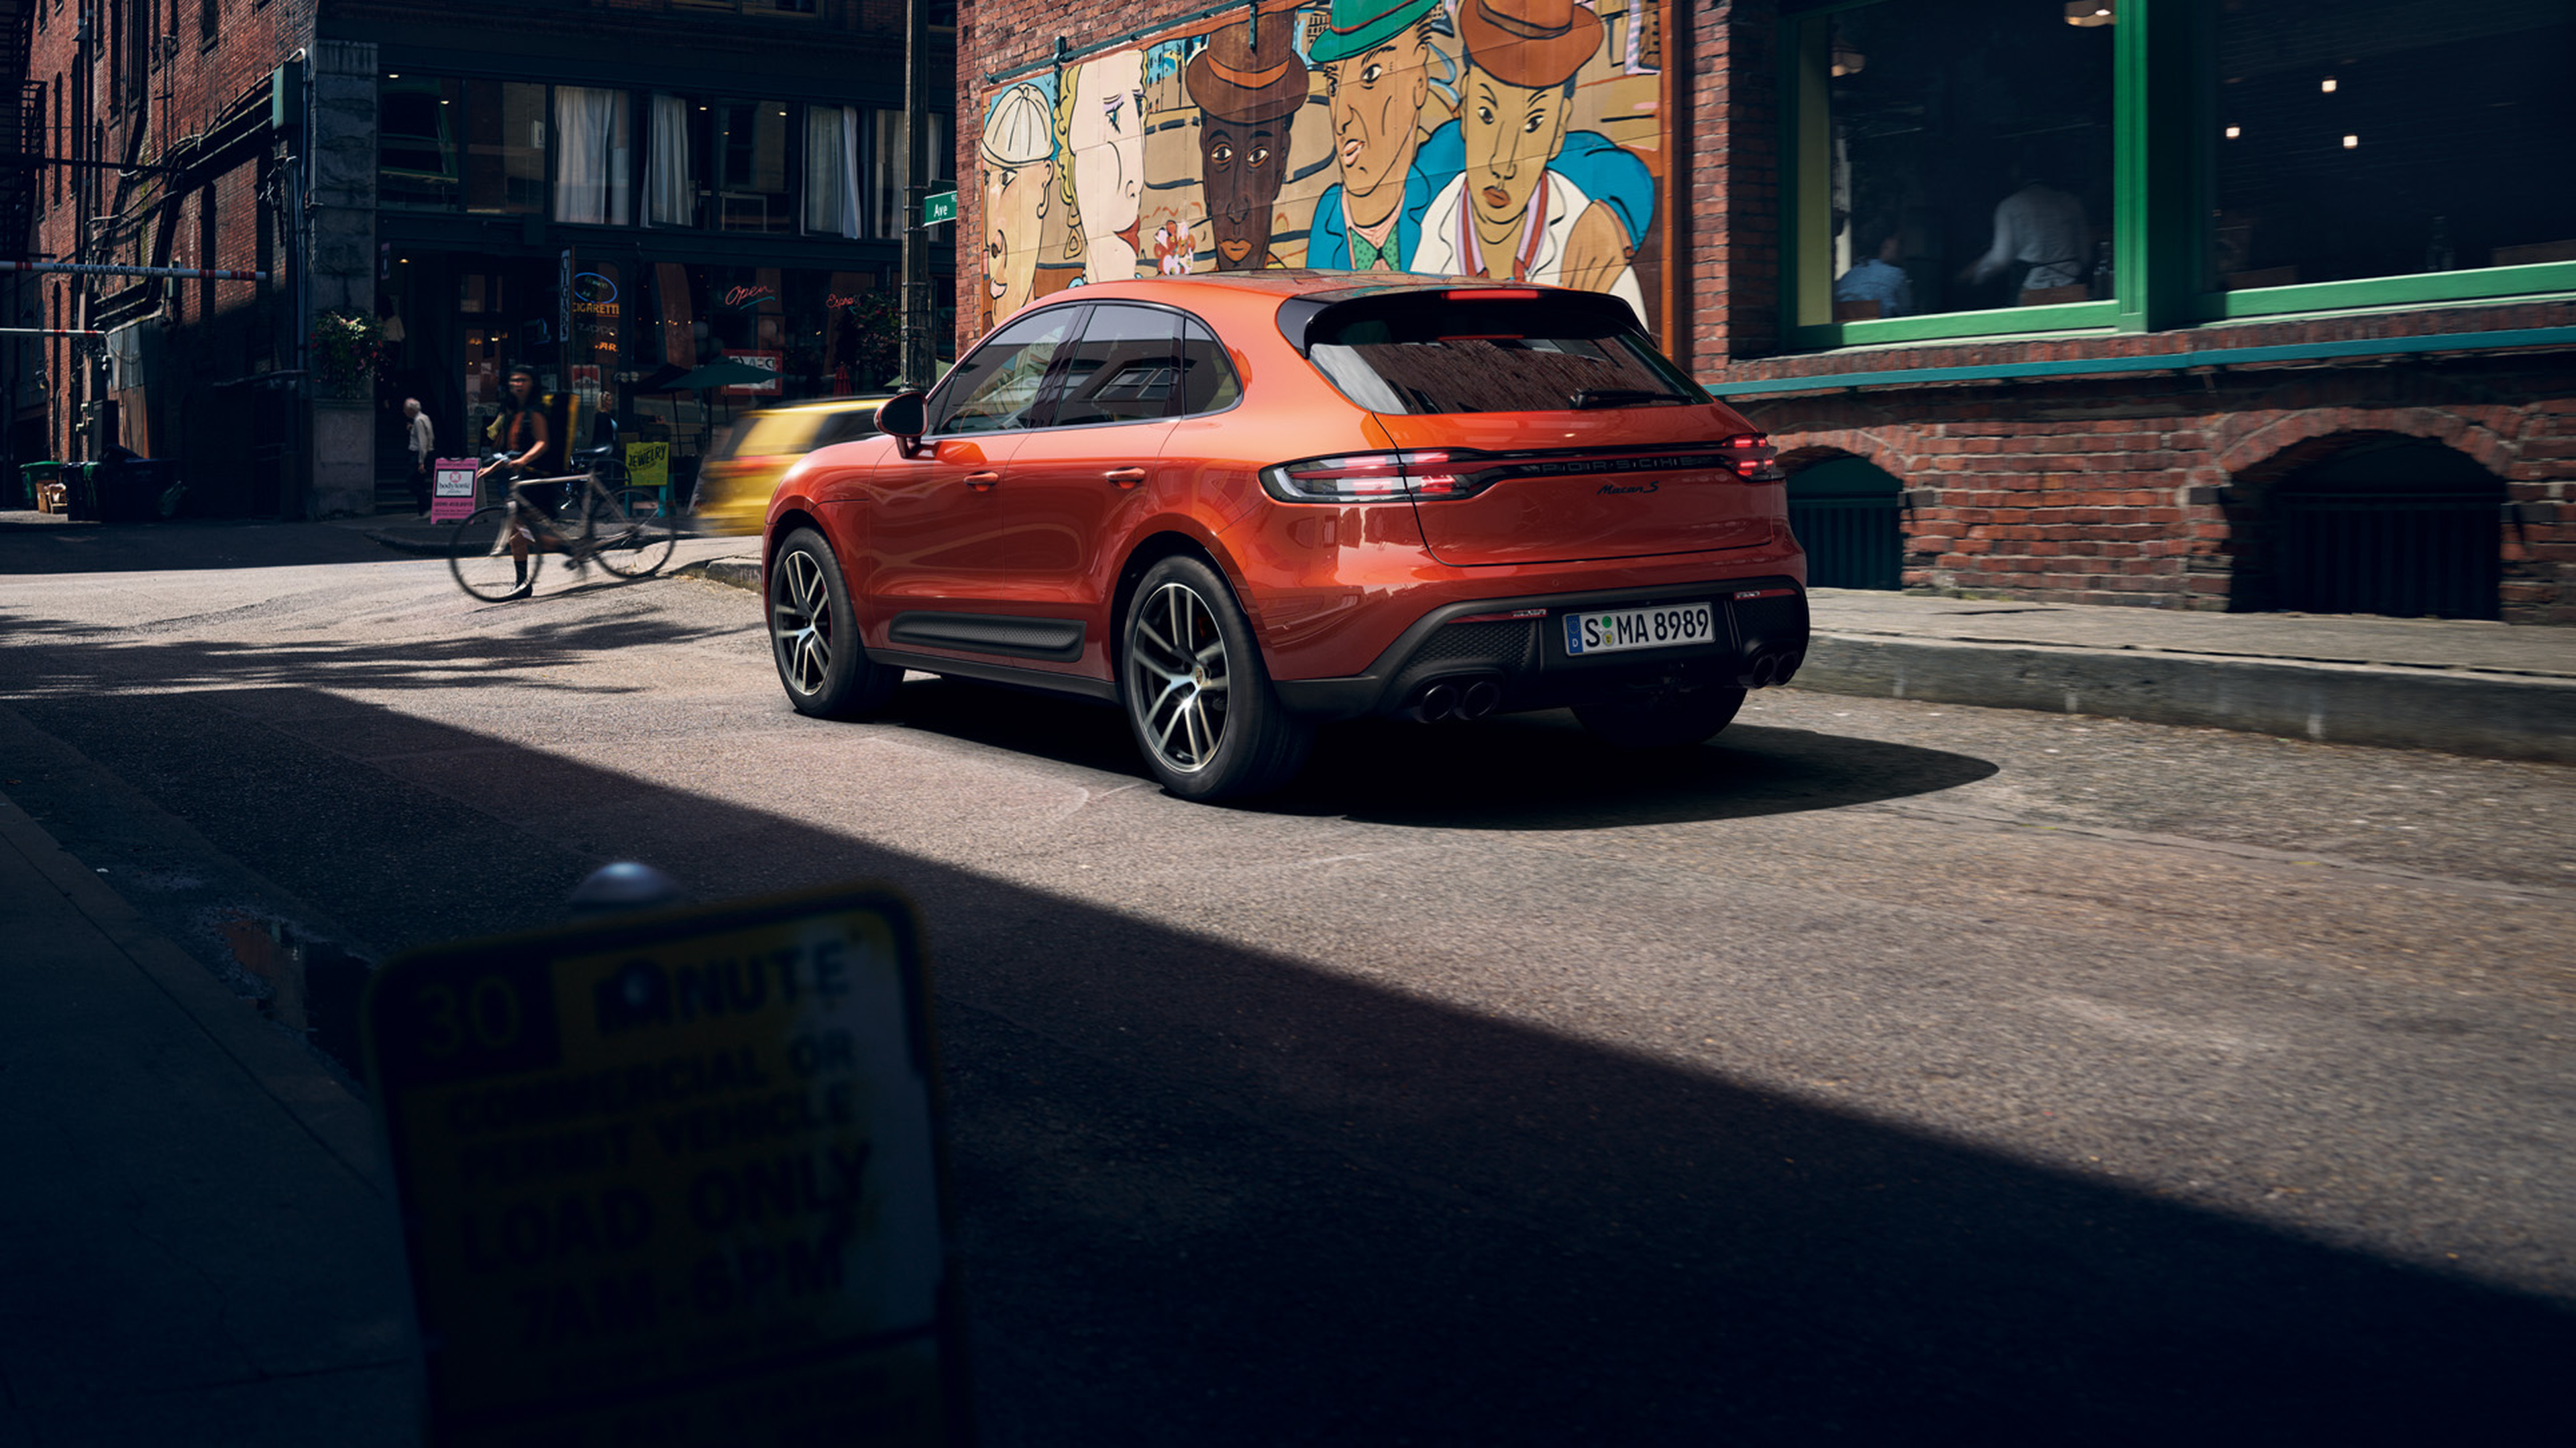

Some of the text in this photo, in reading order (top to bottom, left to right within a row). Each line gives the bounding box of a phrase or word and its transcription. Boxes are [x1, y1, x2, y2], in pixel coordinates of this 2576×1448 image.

[933, 203, 948, 218] Ave
[78, 265, 139, 275] CLEARANCE
[724, 285, 775, 307] Open
[628, 444, 667, 467] JEWELRY
[1542, 456, 1695, 474] PORSCHE
[1597, 481, 1659, 495] Macan S
[1585, 609, 1709, 647] S MA 8989
[1572, 638, 1579, 648] D
[416, 974, 523, 1060] 30
[447, 1029, 854, 1137] COMMERCIAL OR
[460, 1079, 854, 1192] PERMIT VEHICLE
[460, 1141, 873, 1274] LOAD ONLY
